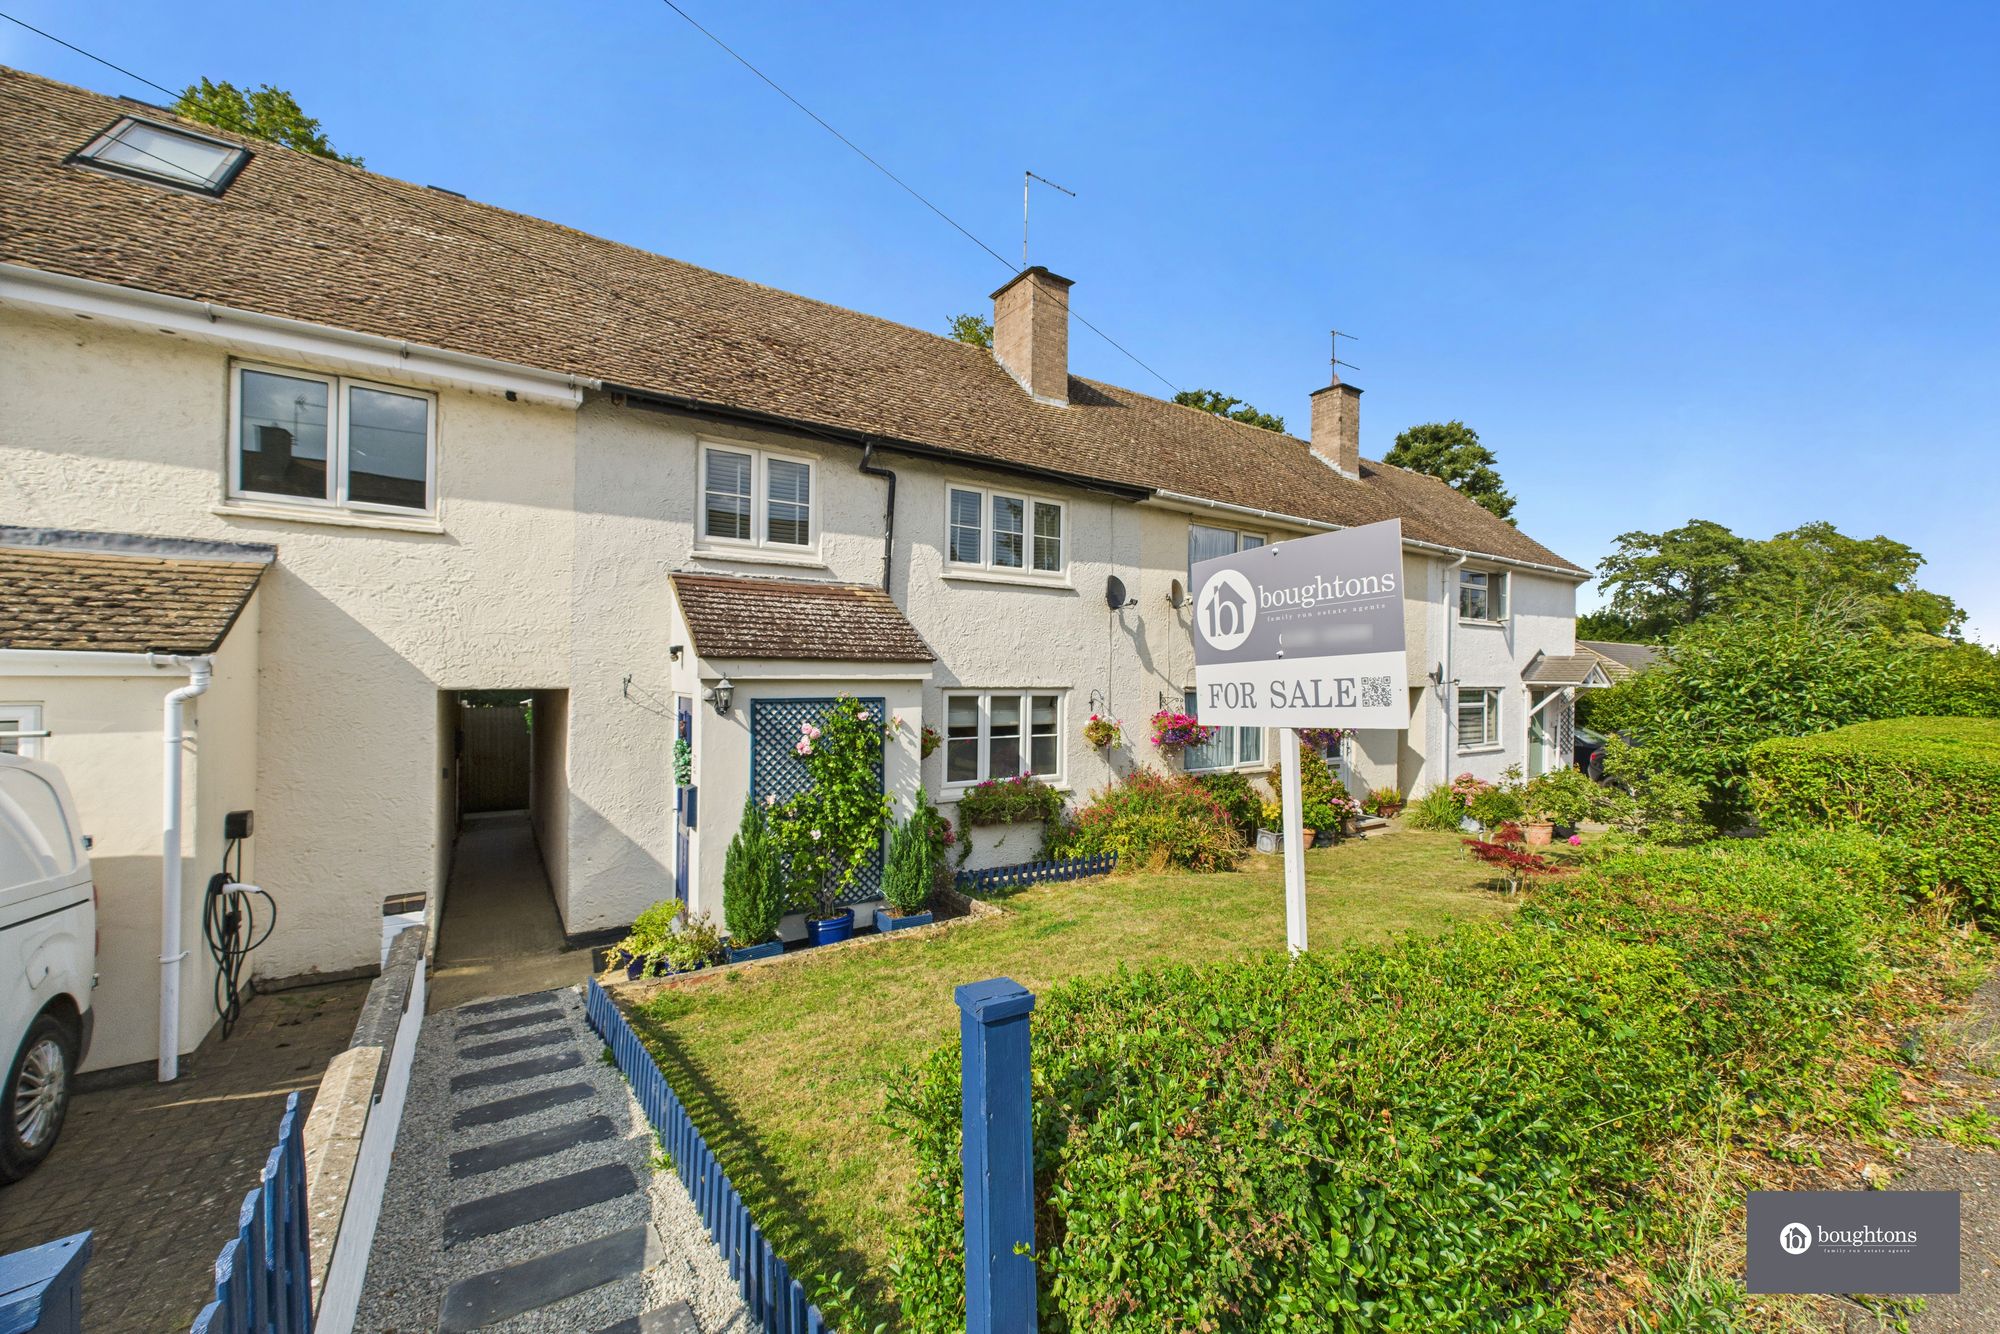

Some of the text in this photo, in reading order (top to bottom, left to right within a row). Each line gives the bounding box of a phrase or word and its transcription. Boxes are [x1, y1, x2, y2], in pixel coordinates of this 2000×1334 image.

[1258, 573, 1396, 608] boughtons
[1267, 613, 1293, 622] family
[1317, 607, 1347, 616] estate
[1352, 603, 1386, 612] agents
[1207, 677, 1357, 709] FOR SALE
